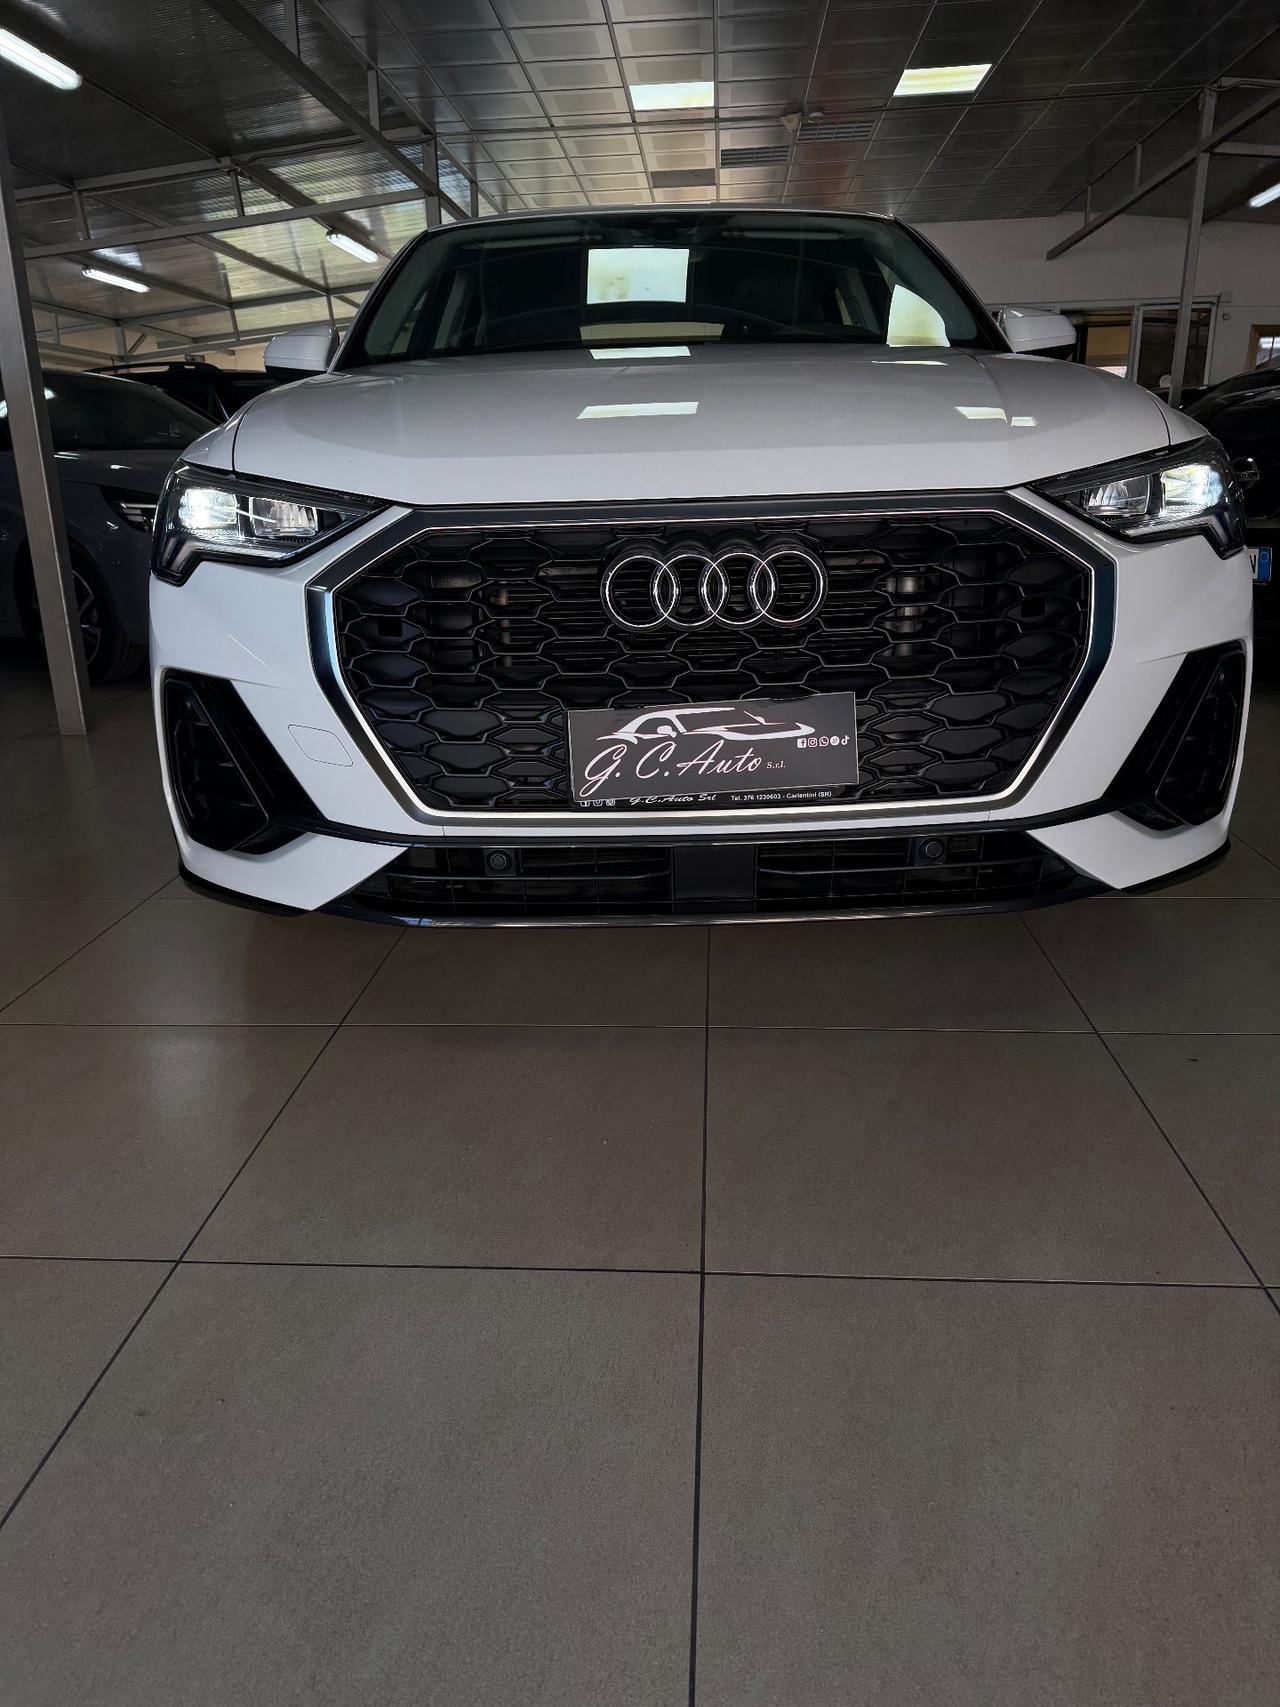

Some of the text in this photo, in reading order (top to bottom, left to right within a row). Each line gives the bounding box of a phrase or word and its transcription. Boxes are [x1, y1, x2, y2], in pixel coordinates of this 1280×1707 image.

[636, 741, 677, 779] C.
[676, 739, 763, 777] Auto
[766, 760, 787, 770] S.r.l.
